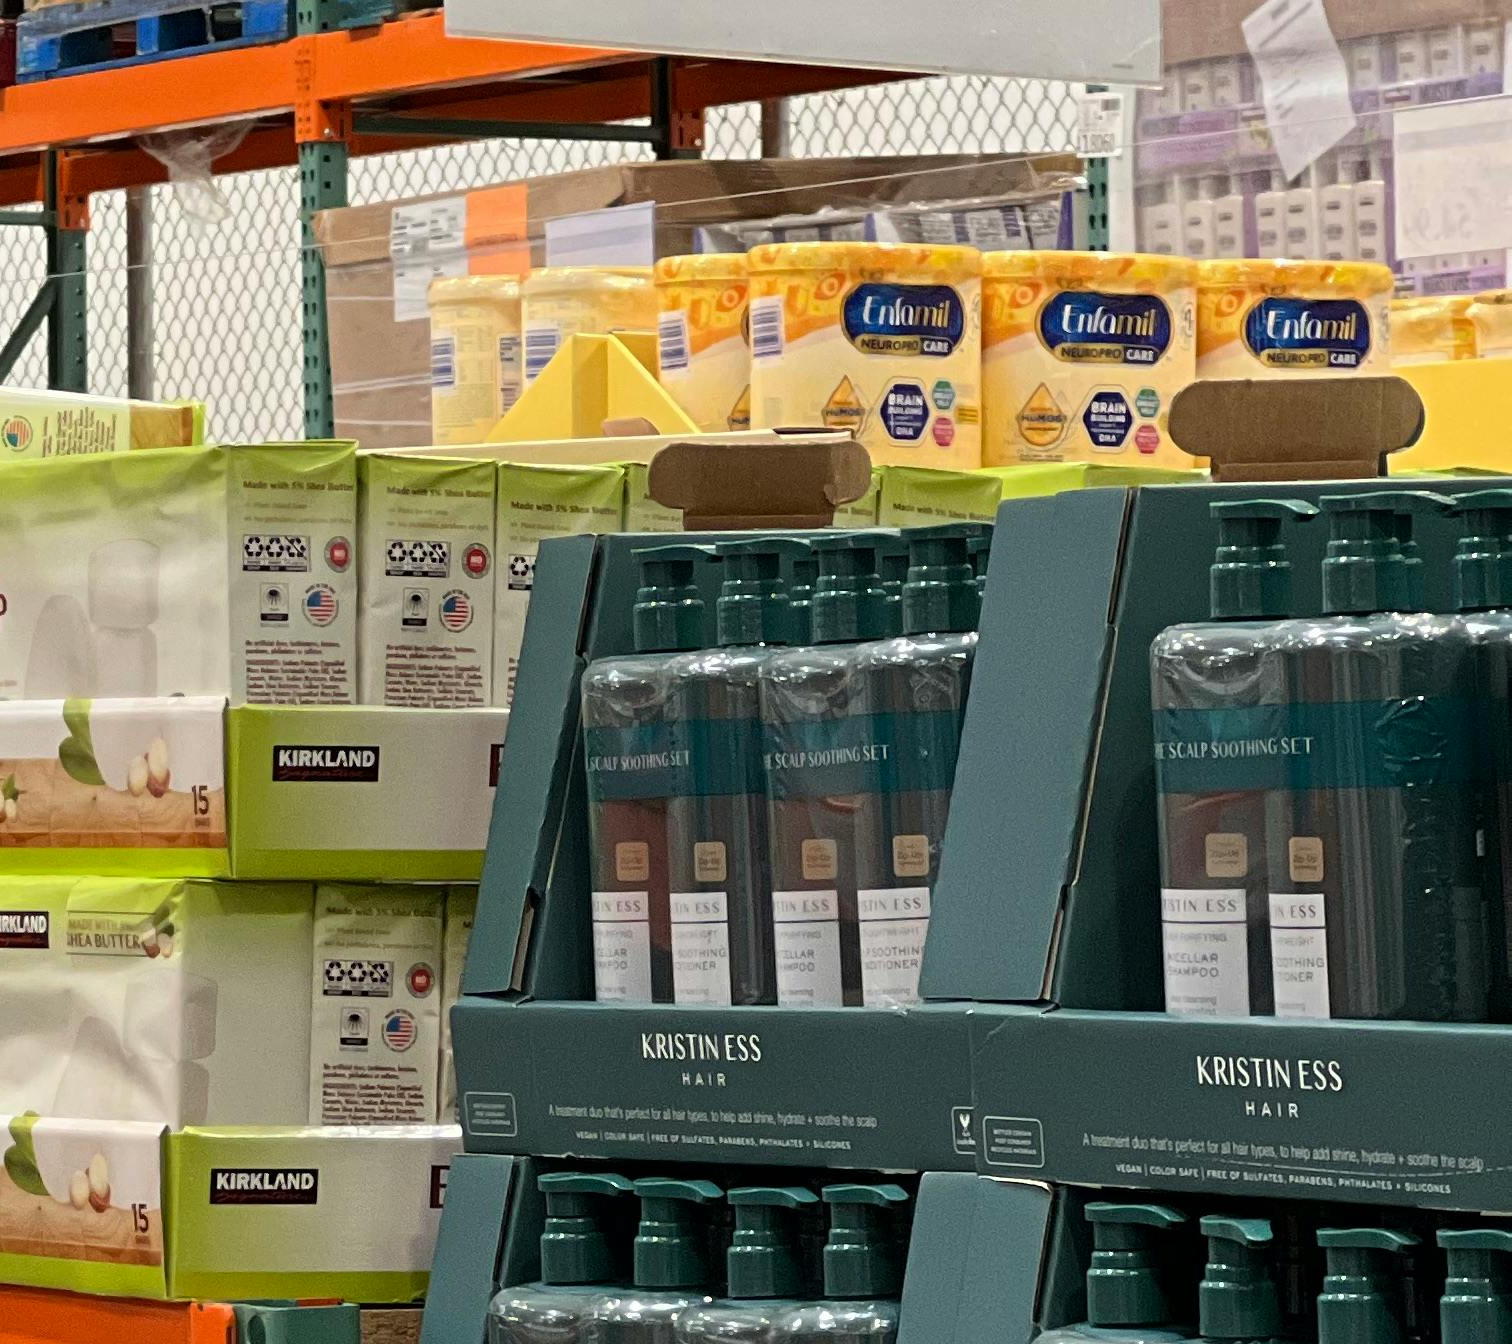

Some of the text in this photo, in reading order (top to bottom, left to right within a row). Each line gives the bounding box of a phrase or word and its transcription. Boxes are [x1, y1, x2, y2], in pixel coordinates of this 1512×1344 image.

[863, 295, 949, 328] Enfamil
[1062, 303, 1157, 337] Enfamil
[861, 339, 949, 352] NEUROPRO CARE
[1062, 346, 1154, 363] NEUROPRO CARE
[888, 394, 923, 407] BRAIN
[279, 749, 375, 769] KIRKLAND
[191, 785, 209, 816] 15
[1196, 1055, 1342, 1092] KRISTIN ESS
[1245, 1101, 1299, 1118] HAIR
[217, 1172, 314, 1190] KIRKLAND
[131, 1204, 148, 1232] 15
